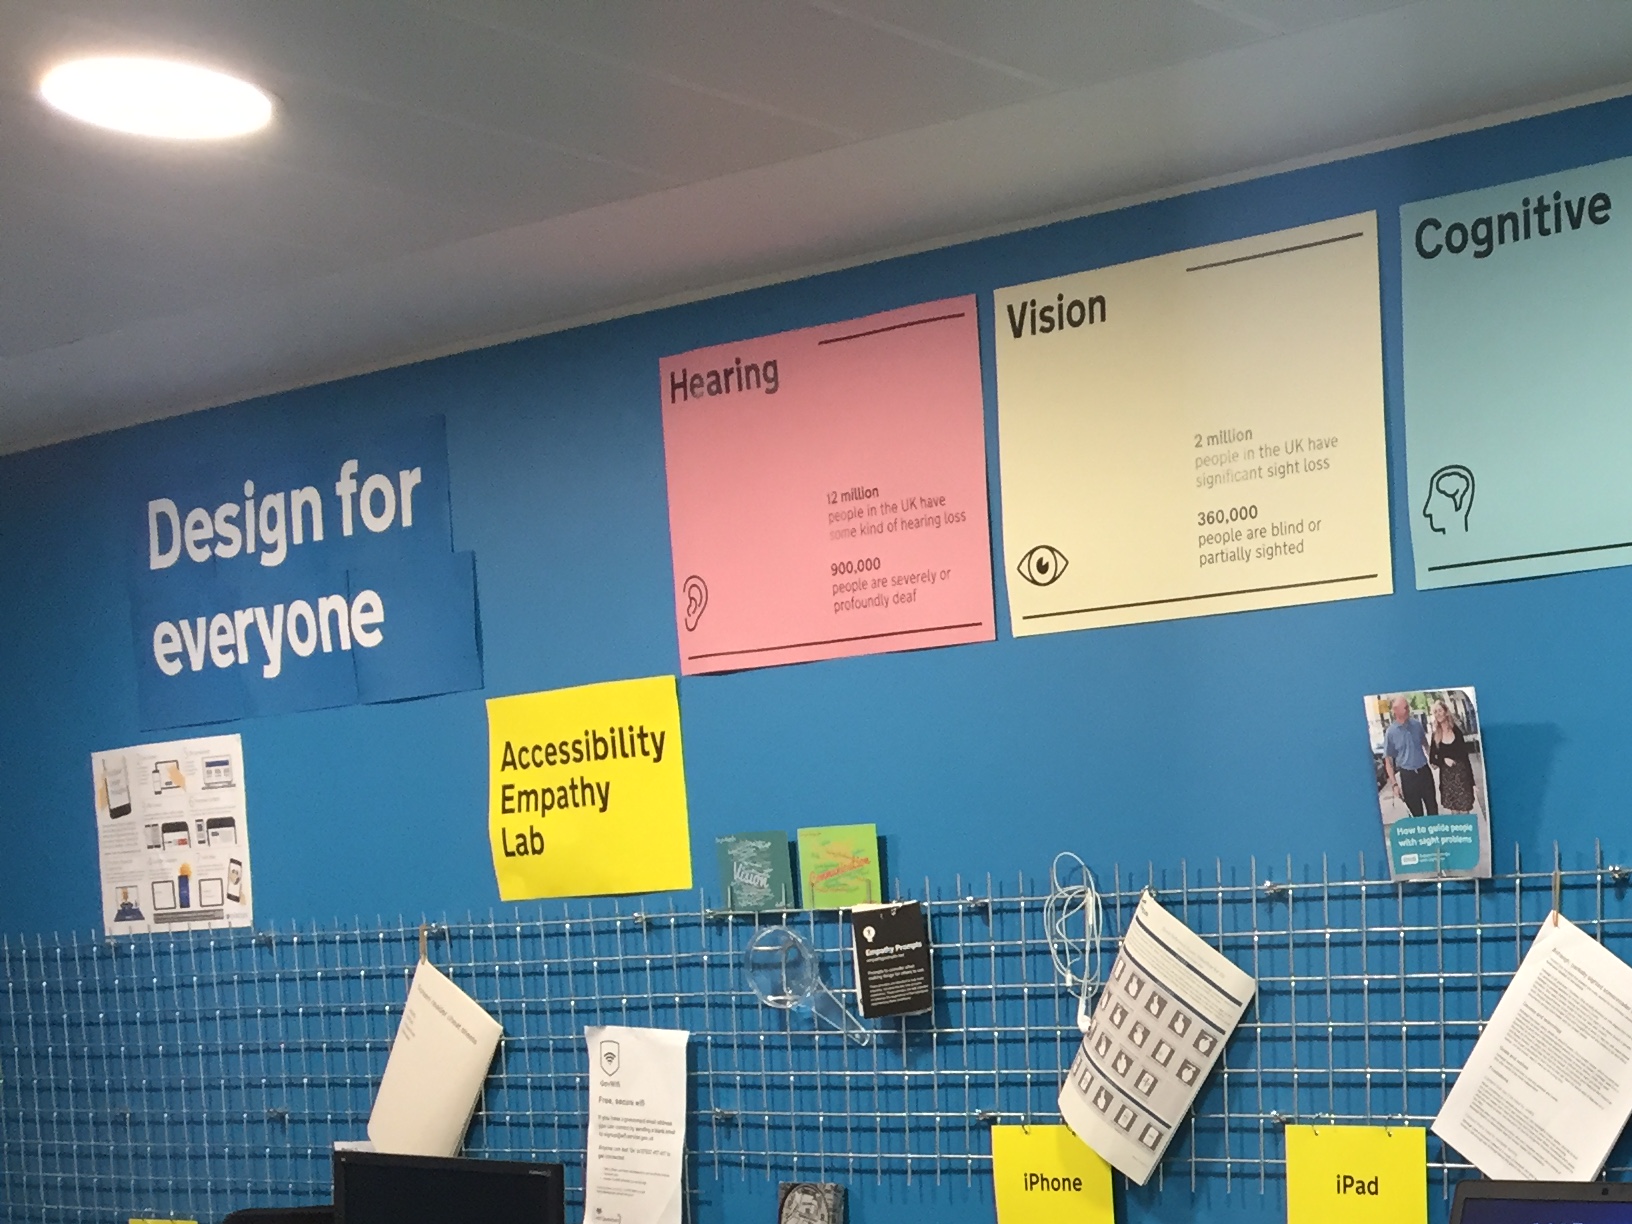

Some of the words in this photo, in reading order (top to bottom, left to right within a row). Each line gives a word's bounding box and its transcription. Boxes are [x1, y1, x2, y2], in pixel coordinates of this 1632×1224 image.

[1415, 190, 1612, 259] Cognitive
[1007, 293, 1107, 338] Vision
[670, 357, 779, 404] Hearing
[1194, 434, 1203, 448] 2
[1207, 429, 1253, 446] million
[1195, 450, 1239, 469] people
[1243, 449, 1255, 460] in
[1259, 444, 1280, 458] the
[1285, 439, 1304, 455] UK
[1308, 436, 1338, 451] have
[1196, 466, 1262, 489] significant
[1267, 461, 1300, 479] sight
[1304, 458, 1330, 473] loss
[841, 486, 879, 502] million
[148, 479, 323, 571] Design
[335, 459, 422, 537] for
[828, 507, 864, 525] people
[867, 504, 877, 517] in
[880, 502, 898, 515] the
[901, 497, 917, 512] UK
[920, 496, 946, 509] have
[860, 522, 883, 536] kind
[887, 518, 898, 532] of
[901, 514, 941, 531] hearing
[945, 511, 966, 524] loss
[1198, 505, 1258, 526] 360,000
[1198, 528, 1242, 548] people
[1247, 527, 1267, 539] are
[1272, 519, 1304, 536] blind
[1308, 520, 1321, 532] or
[831, 557, 881, 576] 900,000
[1200, 547, 1251, 567] partially
[1256, 539, 1304, 560] sighted
[832, 578, 868, 596] people
[871, 577, 888, 589] are
[891, 569, 936, 585] severely
[940, 569, 951, 580] or
[834, 594, 890, 614] profoundly
[892, 589, 917, 605] deaf
[153, 588, 385, 679] everyone
[500, 725, 666, 772] Accessibility
[500, 776, 611, 817] Empathy
[501, 826, 545, 859] Lab
[1023, 1172, 1083, 1194] iPhone
[1336, 1174, 1379, 1197] iPad
